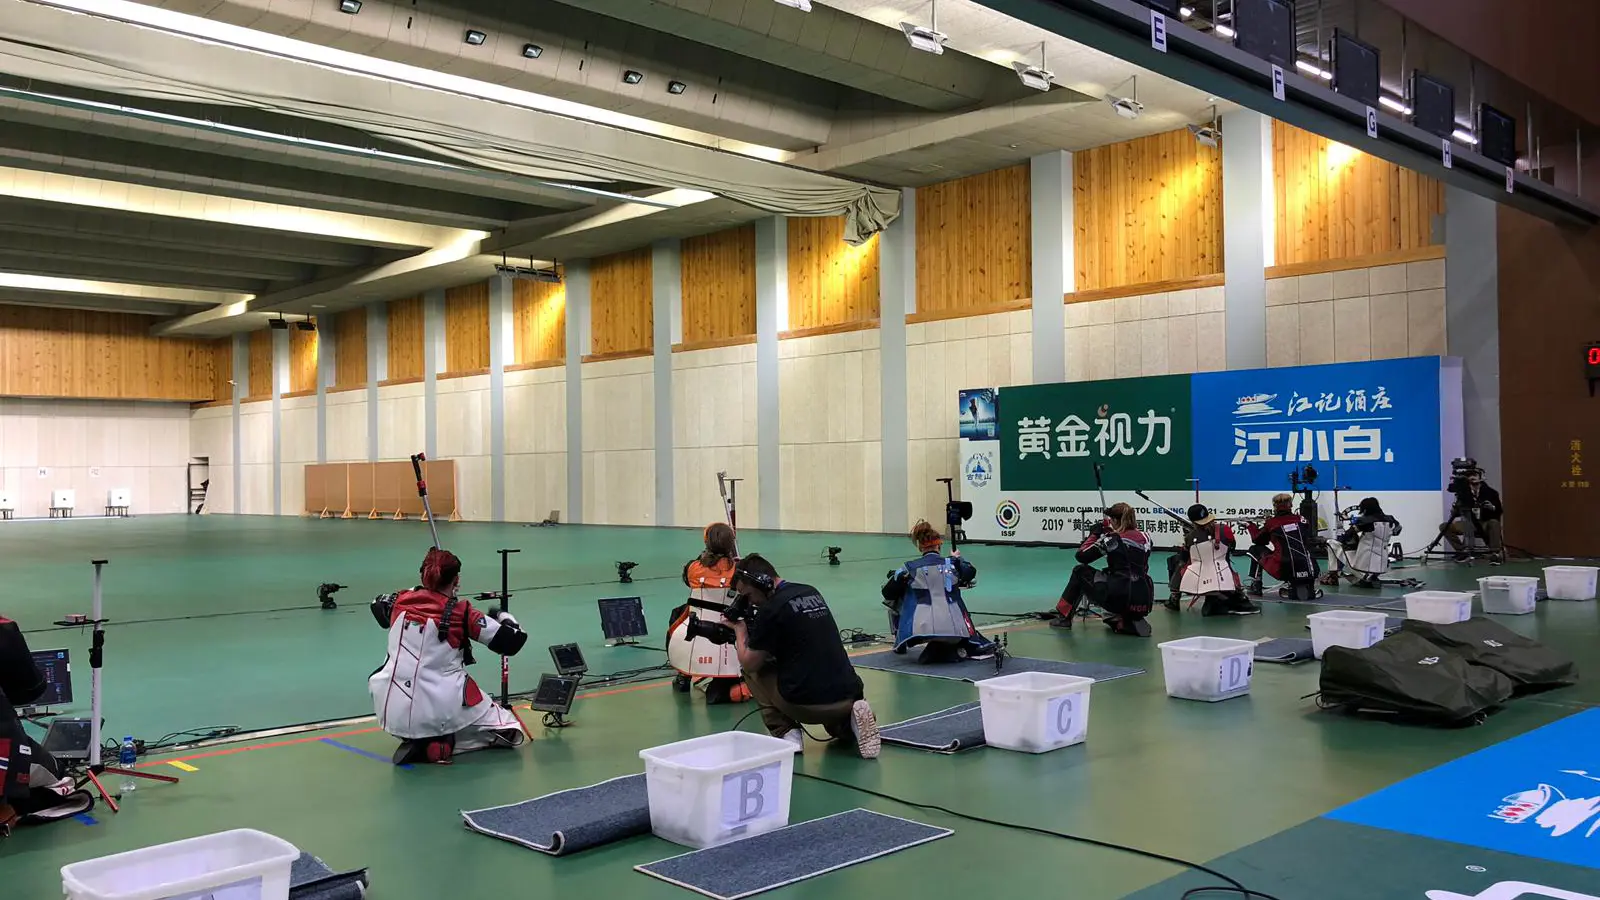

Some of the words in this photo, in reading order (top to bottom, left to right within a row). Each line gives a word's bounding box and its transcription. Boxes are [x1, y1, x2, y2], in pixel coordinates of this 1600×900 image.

[1154, 16, 1164, 45] E
[1274, 69, 1282, 93] F
[1368, 111, 1376, 132] G
[1443, 143, 1451, 165] H
[1287, 386, 1393, 417] 江记酒庄
[1017, 409, 1172, 461] 黄金视力
[1230, 425, 1382, 465] 江小白
[1042, 518, 1064, 531] 2019
[1229, 657, 1242, 687] D
[1057, 698, 1072, 735] C
[739, 772, 764, 822] B
